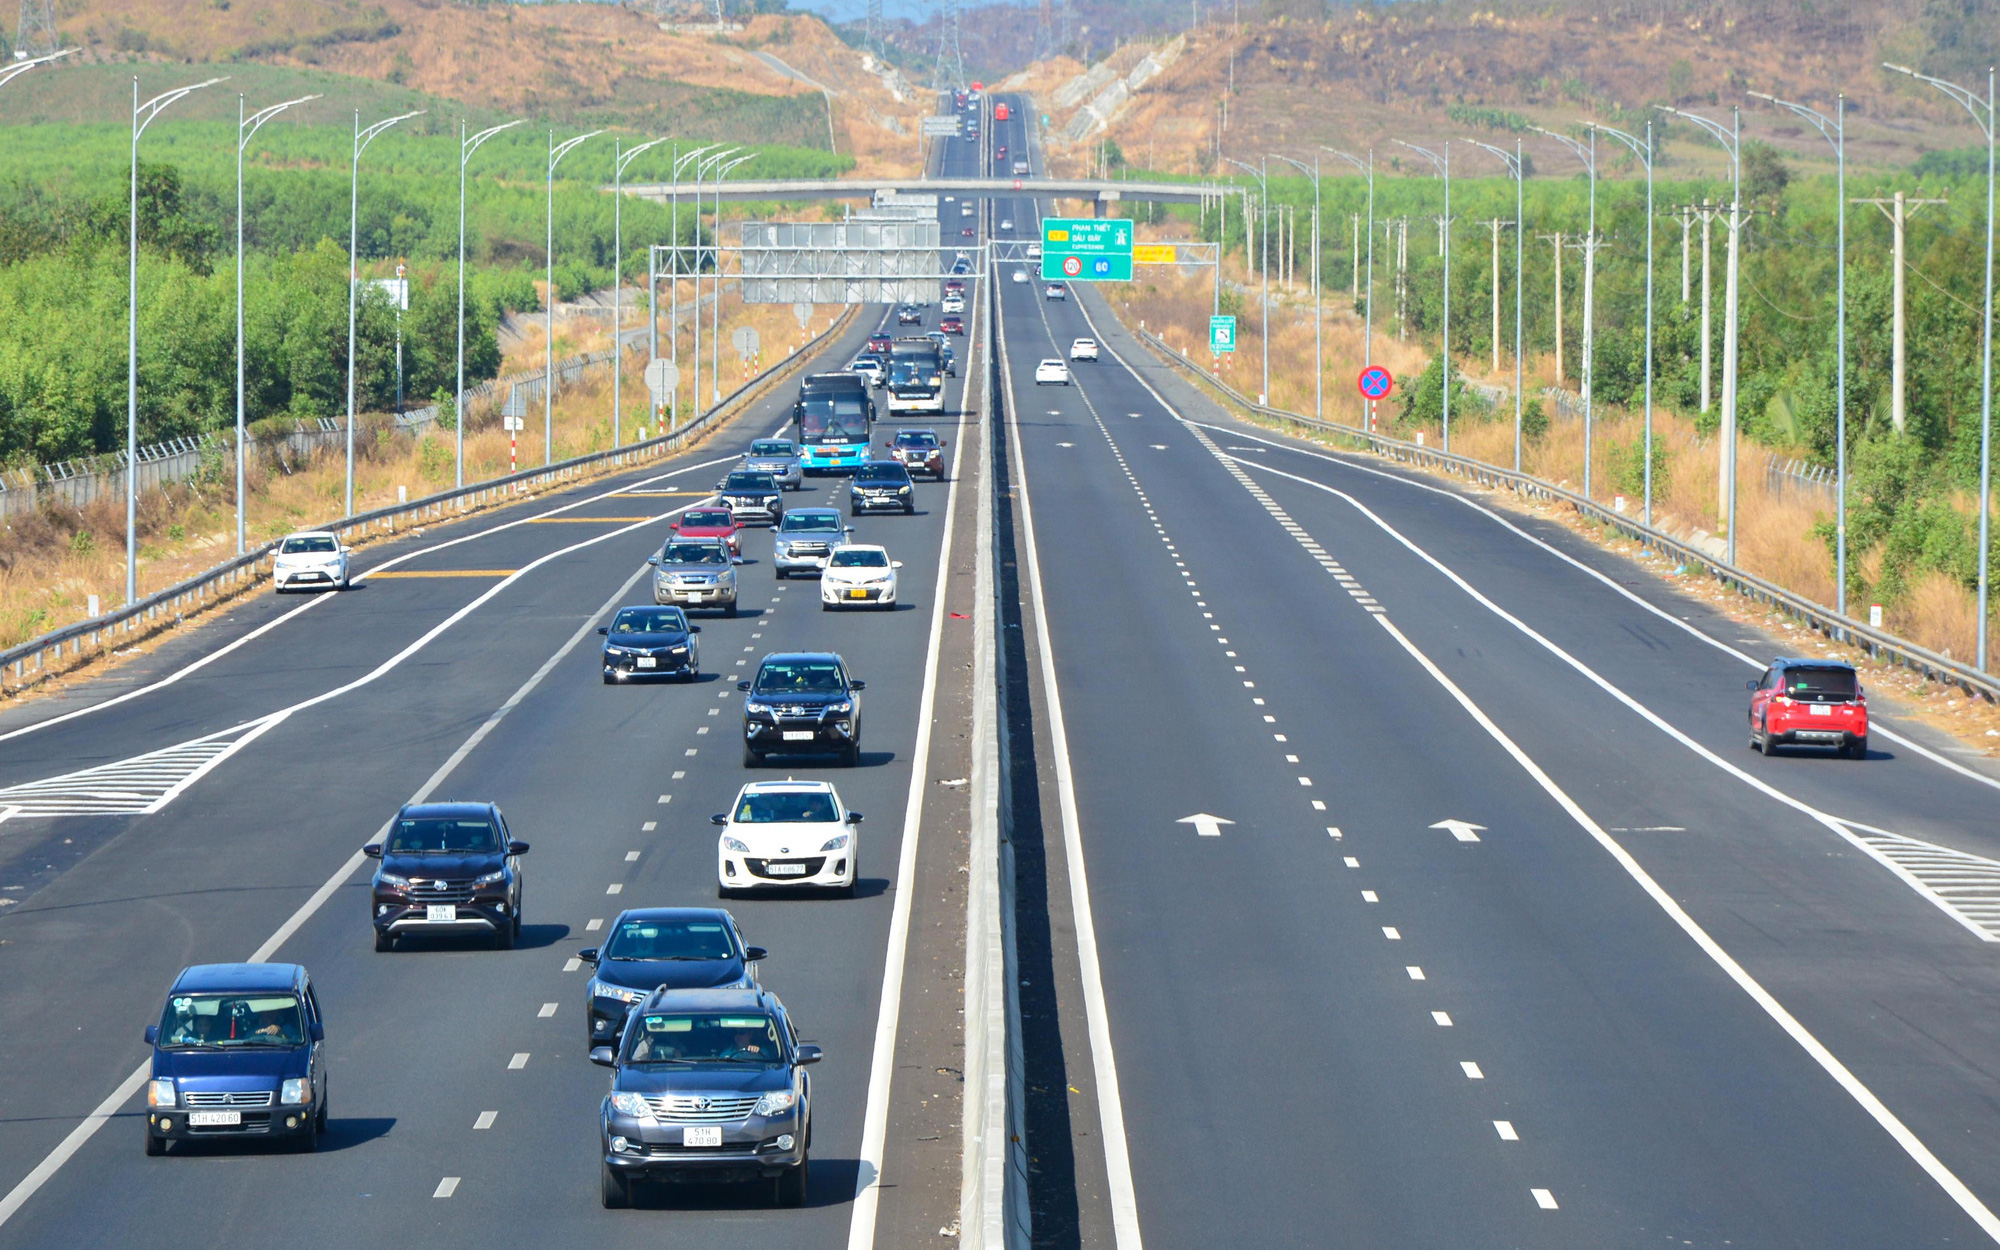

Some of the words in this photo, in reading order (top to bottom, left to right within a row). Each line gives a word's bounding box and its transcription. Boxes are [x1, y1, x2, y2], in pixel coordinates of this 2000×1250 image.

[1067, 261, 1078, 271] 120
[191, 1113, 208, 1123] 51H
[694, 1128, 711, 1136] 51H
